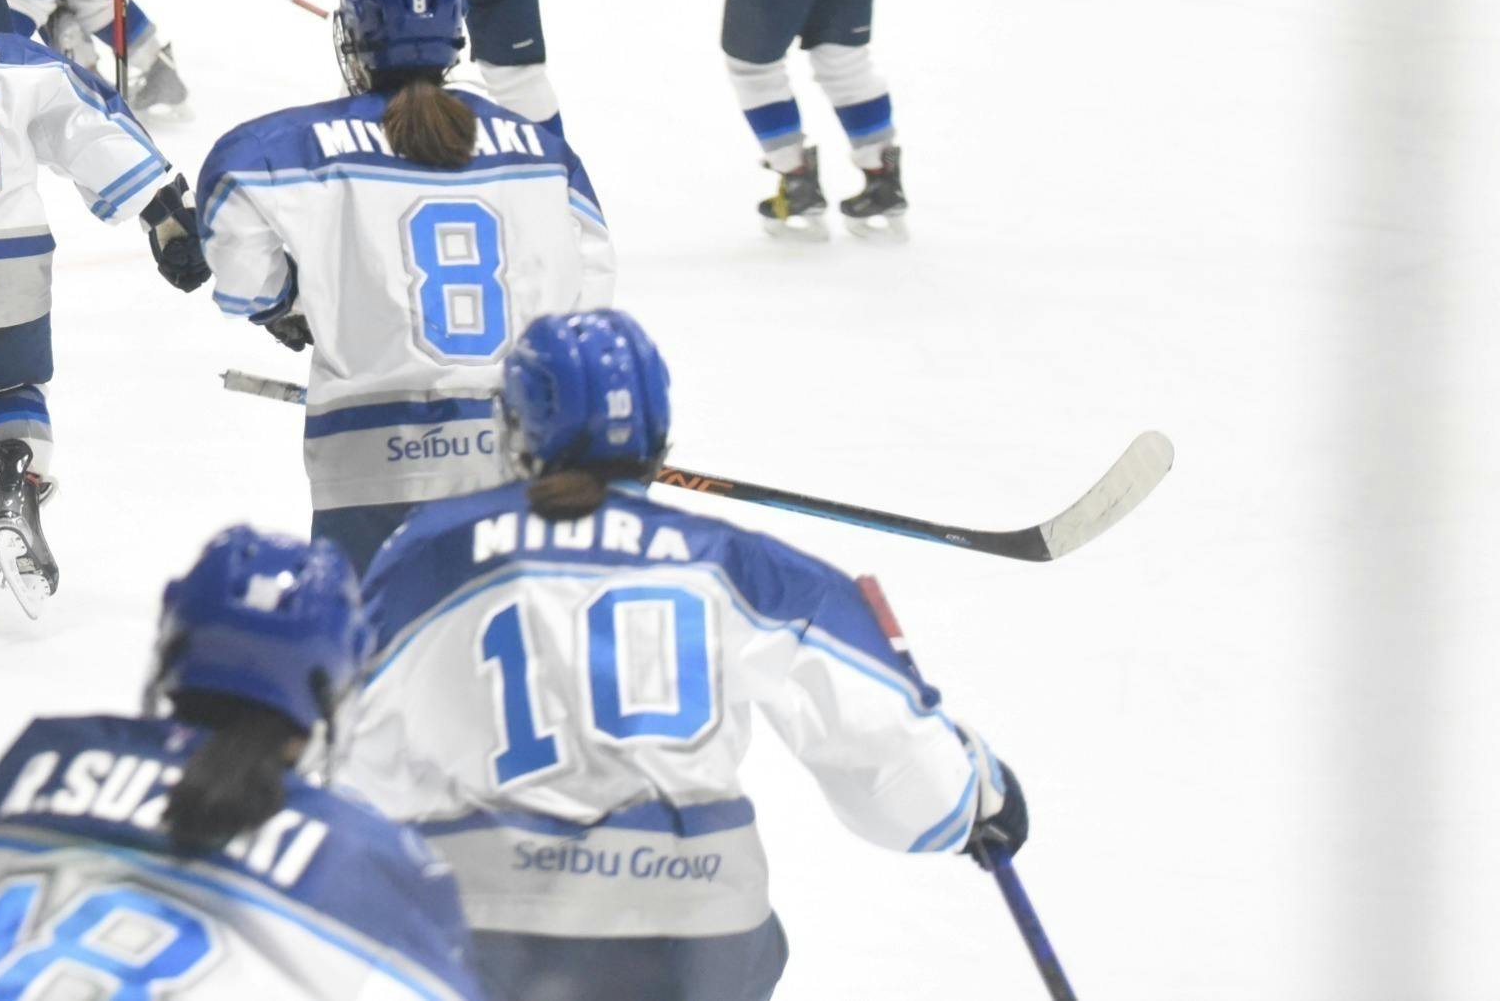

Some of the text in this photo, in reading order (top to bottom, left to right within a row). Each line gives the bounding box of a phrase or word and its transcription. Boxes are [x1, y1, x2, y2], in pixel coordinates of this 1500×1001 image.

[312, 117, 545, 159] MIYAKI
[398, 194, 514, 367] 8
[386, 427, 470, 462] Seibu
[472, 507, 692, 564] MIURA
[475, 579, 724, 789] 10
[512, 832, 621, 879] Seibu
